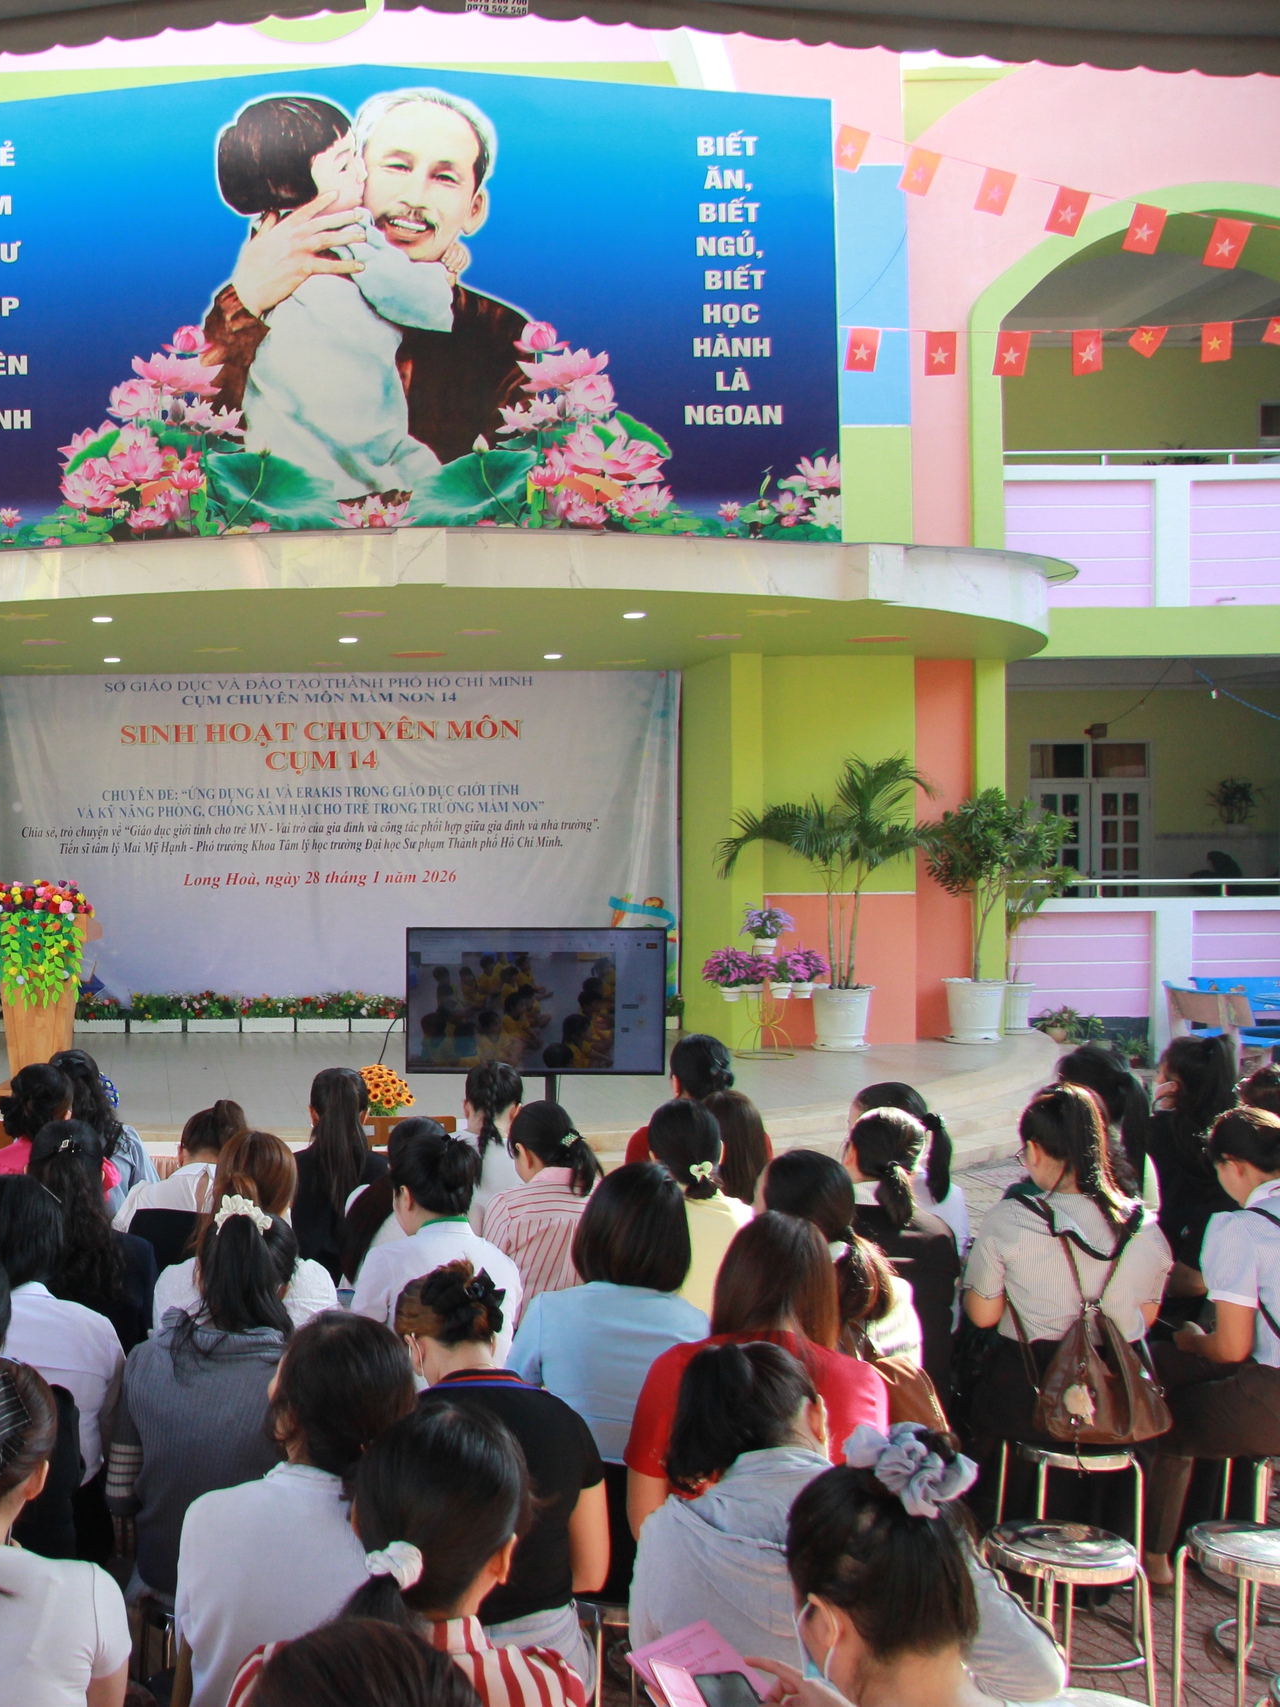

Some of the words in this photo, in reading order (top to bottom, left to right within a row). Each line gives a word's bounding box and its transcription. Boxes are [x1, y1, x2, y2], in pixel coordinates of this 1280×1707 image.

[697, 130, 759, 157] BIẾT
[703, 165, 753, 192] ĂN,
[698, 197, 760, 224] BIẾT
[696, 230, 764, 260] NGỦ,
[704, 264, 766, 291] BIẾT
[702, 303, 760, 328] HỌC
[692, 334, 771, 358] HÀNH
[715, 367, 750, 392] LÀ
[684, 405, 782, 426] NGOAN
[105, 679, 126, 693] SỞ
[131, 678, 172, 691] GIÁO
[178, 680, 212, 693] DỤC
[217, 677, 240, 691] VÀ
[245, 676, 281, 690] ĐÀO
[287, 678, 321, 693] TẠO
[324, 675, 383, 689] THÀNH
[456, 674, 484, 687] CHÍ
[489, 676, 533, 687] MINH
[182, 696, 221, 708] CỤM
[227, 692, 299, 705] CHUYÊN
[305, 692, 344, 704] MÔN
[399, 693, 435, 703] NON
[442, 692, 457, 702] 14
[121, 724, 196, 745] SINH
[206, 722, 295, 748] HOẠT
[303, 716, 437, 741] CHUYÊN
[447, 715, 521, 740] MÔN
[266, 751, 338, 775] CỤM
[349, 750, 377, 769] 14
[102, 787, 154, 801] CHUYÊN
[219, 788, 254, 803] DỤNG
[276, 784, 293, 798] VÀ
[297, 787, 342, 798] ERAKIS
[345, 786, 389, 797] TRONG
[393, 782, 425, 797] GIÁO
[428, 785, 455, 799] DỤC
[458, 782, 485, 796] GIỚI
[489, 782, 520, 796] TÍNH
[77, 804, 94, 819] VÀ
[98, 805, 115, 818] KỸ
[119, 805, 154, 818] NĂNG
[158, 804, 205, 819] PHÒNG,
[257, 801, 286, 816] XÂM
[289, 804, 311, 818] HẠI
[315, 803, 342, 815] CHO
[345, 800, 370, 815] TRẺ
[374, 802, 417, 815] TRONG
[420, 800, 474, 814] TRƯỜNG
[512, 801, 545, 813] NON”
[22, 826, 43, 839] Chia
[60, 826, 73, 838] trò
[76, 826, 109, 840] chuyện
[154, 825, 171, 839] dục
[173, 824, 192, 838] giới
[194, 824, 212, 836] tính
[215, 823, 231, 835] cho
[234, 823, 247, 834] trẻ
[249, 823, 268, 834] MN
[276, 822, 291, 834] Vai
[293, 822, 306, 833] trò
[308, 822, 324, 833] của
[326, 824, 341, 836] gia
[343, 821, 364, 833] đình
[368, 822, 378, 833] và
[380, 821, 402, 835] công
[405, 820, 419, 833] tác
[421, 818, 443, 835] phối
[444, 820, 462, 835] hợp
[464, 820, 485, 834] giữa
[487, 821, 502, 834] gia
[504, 819, 525, 831] đình
[528, 819, 538, 831] và
[541, 819, 558, 831] nhà
[60, 839, 79, 855] Tiến
[92, 843, 109, 854] tâm
[112, 842, 120, 856] lý
[122, 842, 141, 853] Mai
[143, 842, 158, 856] Mỹ
[161, 841, 187, 855] Hạnh
[196, 841, 214, 852] Phó
[251, 839, 276, 851] Khoa
[279, 839, 299, 851] Tâm
[302, 839, 310, 853] lý
[312, 839, 328, 853] học
[330, 838, 362, 853] trường
[365, 838, 382, 852] Đại
[384, 838, 401, 852] học
[403, 838, 417, 849] Sư
[418, 838, 445, 852] phạm
[448, 837, 478, 849] Thành
[480, 834, 498, 851] phố
[500, 833, 514, 848] Hồ
[517, 836, 534, 848] Chí
[536, 836, 563, 848] Minh.
[184, 873, 221, 889] Long
[226, 873, 260, 887] Hoà,
[265, 872, 300, 888] ngày
[305, 872, 320, 885] 28
[325, 871, 368, 887] tháng
[373, 871, 379, 884] 1
[385, 871, 416, 884] năm
[422, 870, 457, 883] 2026
